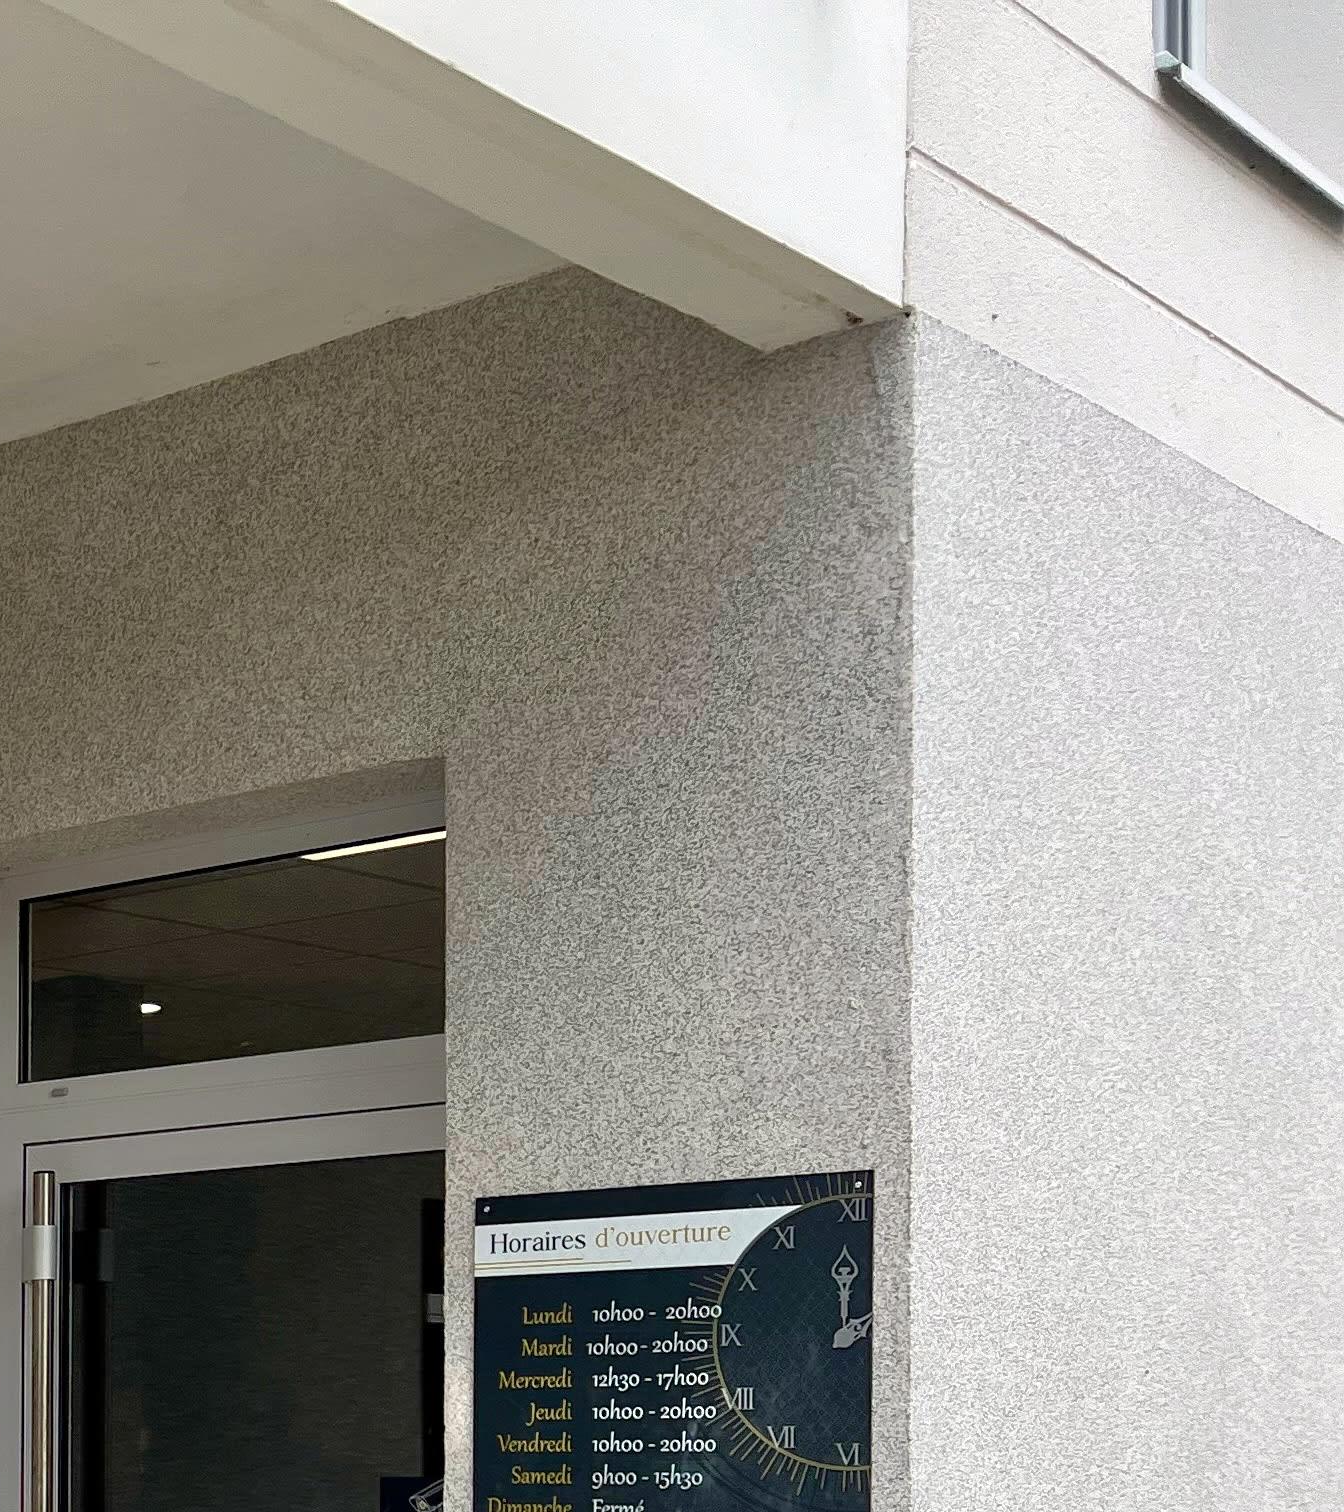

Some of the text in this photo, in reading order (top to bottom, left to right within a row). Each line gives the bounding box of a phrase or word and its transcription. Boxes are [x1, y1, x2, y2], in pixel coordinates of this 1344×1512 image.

[837, 1198, 869, 1222] XII
[490, 1222, 796, 1255] Horaires d'ouverture XI
[738, 1268, 759, 1292] X
[522, 1298, 722, 1325] Lundi 10h00 20h00
[521, 1331, 708, 1357] Mardi 10h00 20h00
[720, 1324, 744, 1347] IX
[498, 1365, 709, 1392] Mercredi 12h30 17h00
[526, 1396, 717, 1426] Jeudi 10h00 20h00
[496, 1430, 717, 1453] Vendredi 10h00 20h00
[767, 1425, 860, 1466] VII VI
[511, 1462, 703, 1489] Samedi 9h00 15h30
